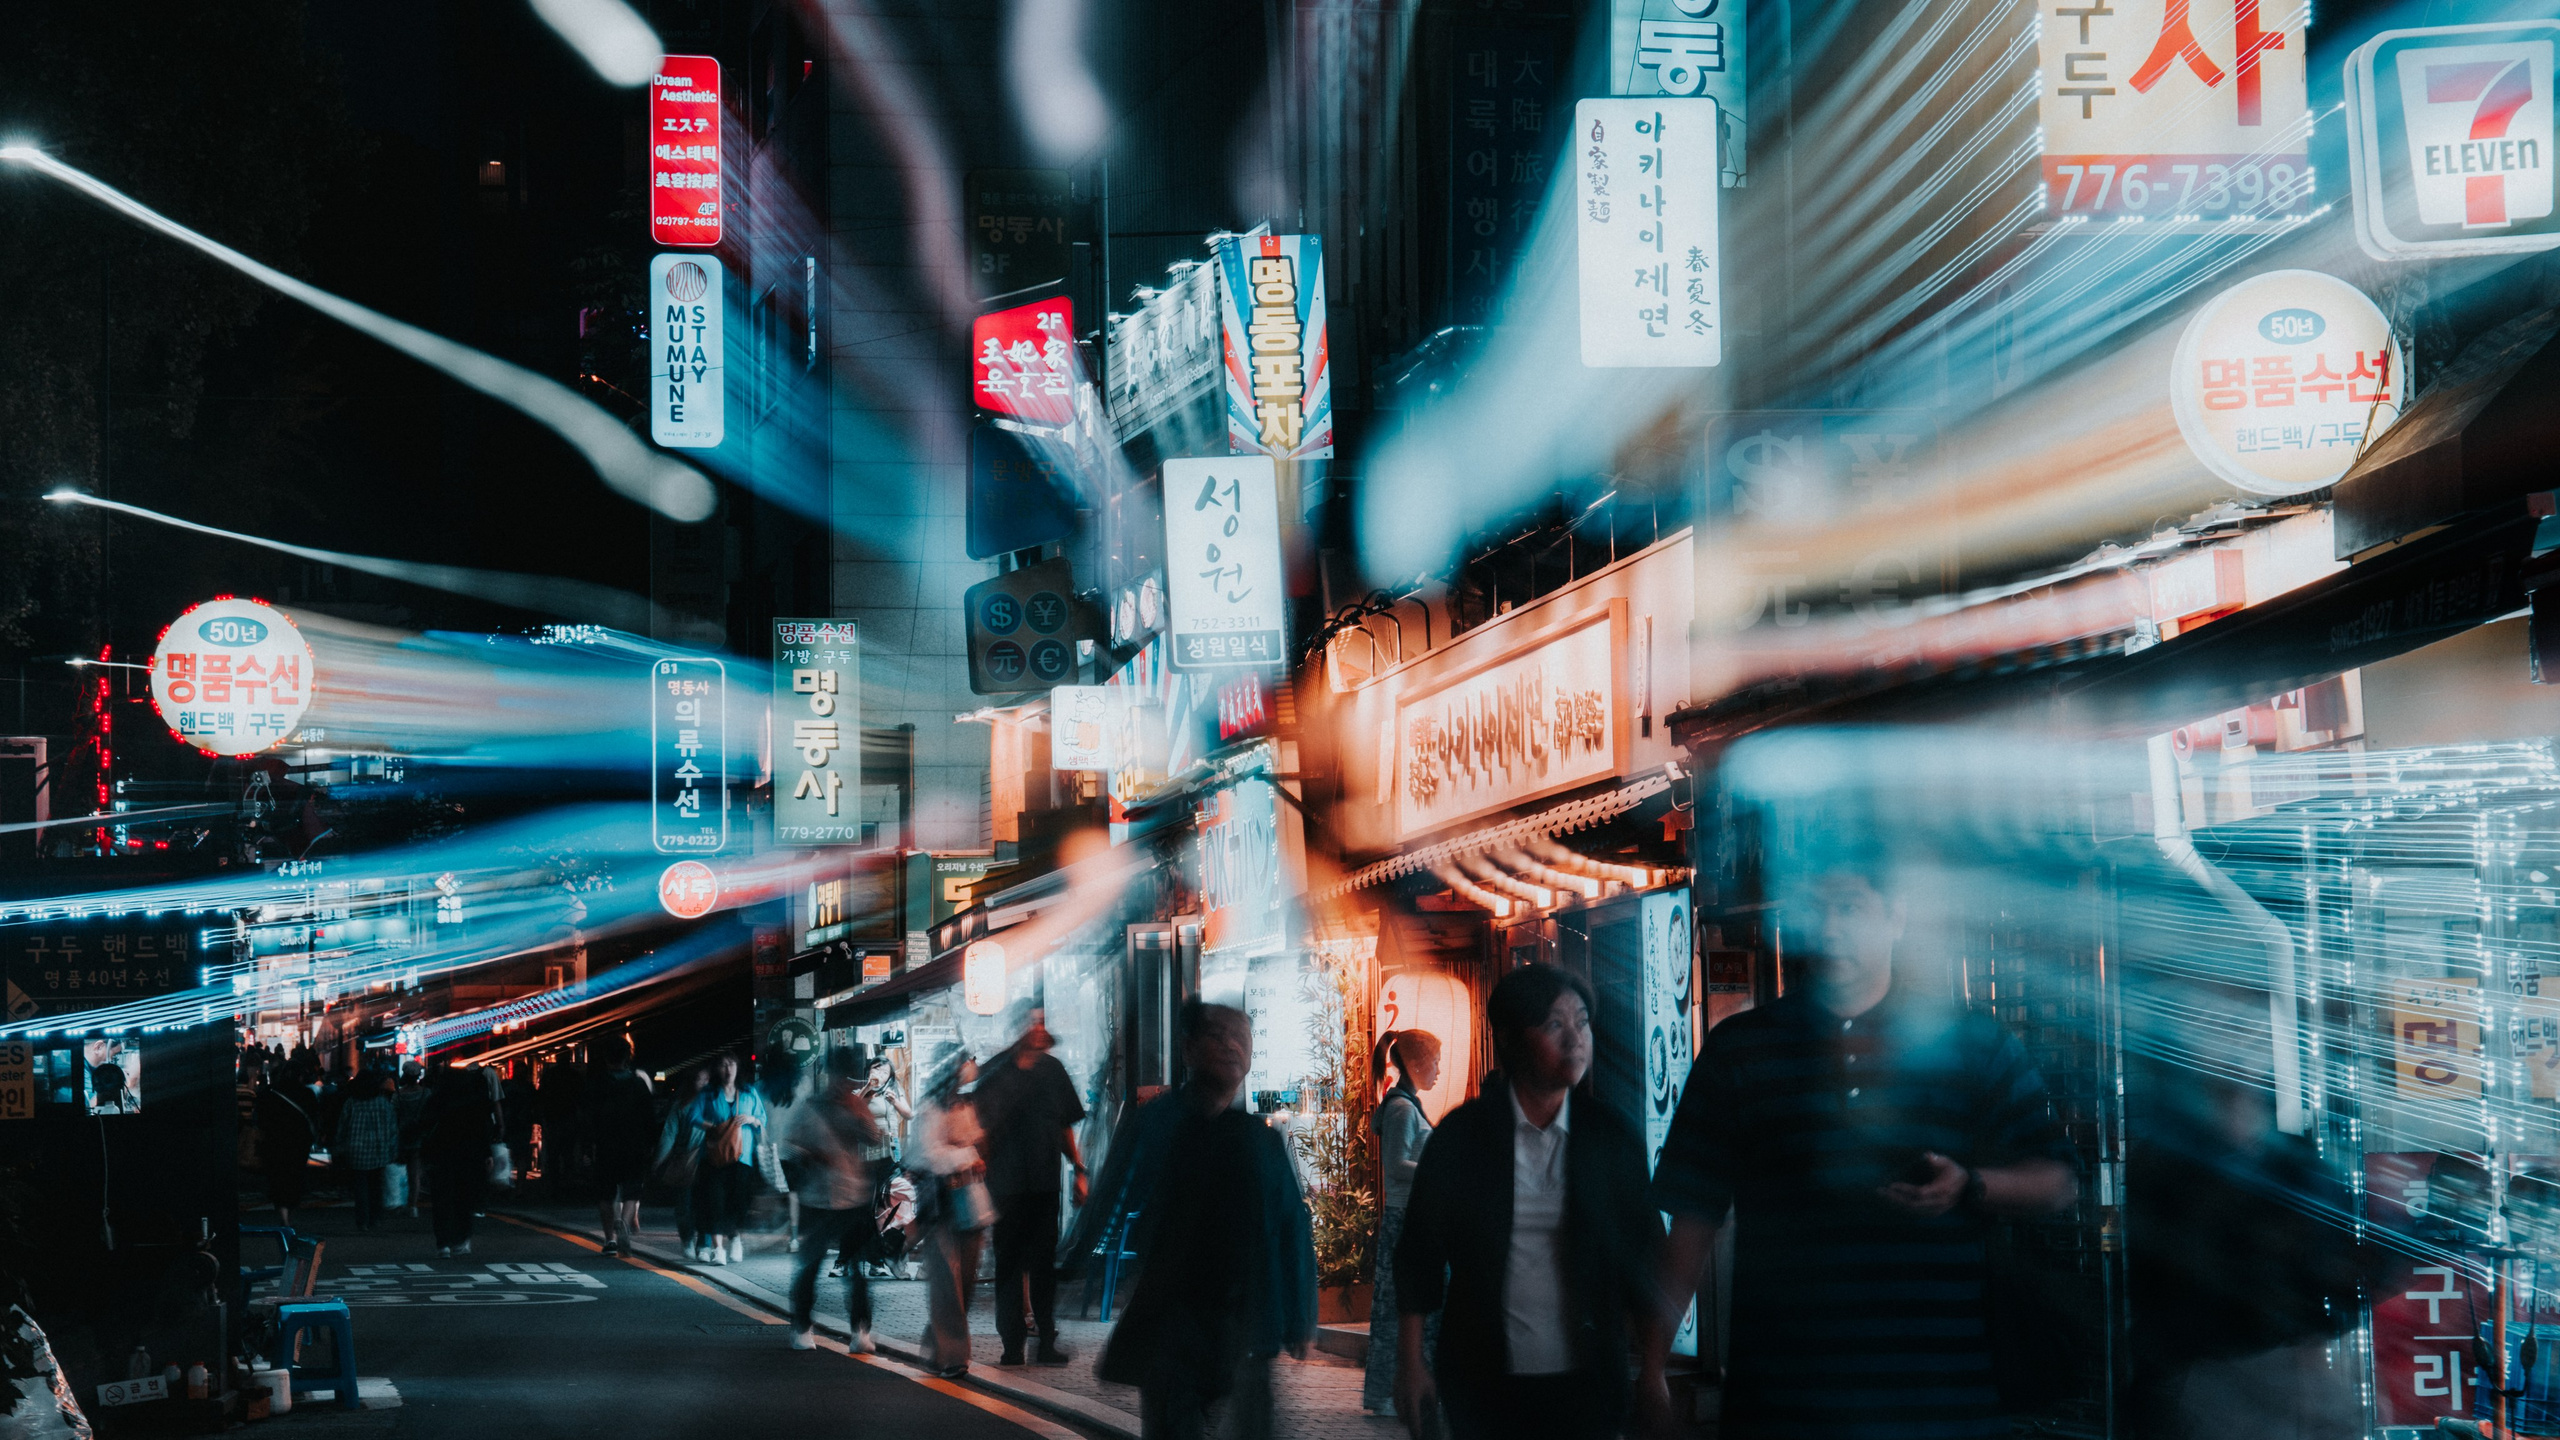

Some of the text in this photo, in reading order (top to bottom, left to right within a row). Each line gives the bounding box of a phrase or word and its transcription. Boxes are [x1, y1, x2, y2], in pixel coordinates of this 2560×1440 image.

[654, 74, 692, 87] Dream
[660, 88, 717, 103] Aesthetic
[663, 118, 709, 133] エステ
[655, 144, 717, 162] 에스테틱
[1465, 50, 1501, 286] 대륙여행사
[655, 172, 718, 189] 美容按摩
[2057, 163, 2297, 211] 776-7398
[698, 202, 717, 215] 4F
[656, 216, 718, 226] 02)797-9633
[979, 215, 1065, 245] 명동사
[1634, 110, 1670, 338] 아키나이제면
[981, 253, 1010, 274] 3F
[1684, 245, 1713, 336] 春夏冬
[1036, 312, 1062, 329] 2F
[2270, 316, 2315, 338] 50년
[690, 305, 708, 384] STAY
[978, 335, 1069, 370] 王妃家
[1249, 256, 1305, 448] 명동포차
[666, 305, 687, 423] MUMUNE
[2201, 350, 2391, 411] 명품수선
[1194, 474, 1254, 605] 성원
[209, 621, 258, 643] 50년
[778, 622, 857, 645] 명품수선
[1191, 615, 1262, 631] 752-3311
[1186, 634, 1270, 658] 성원일식
[166, 652, 299, 706] 명품수선
[661, 663, 678, 675] B1
[667, 680, 710, 696] 명동사
[301, 728, 325, 743] 부동산
[792, 668, 843, 817] 명동사
[673, 698, 703, 819] 의류수선
[661, 835, 718, 846] 779-0222
[780, 826, 855, 840] 779-2770
[936, 862, 967, 872] 오리지날
[665, 878, 712, 901] 사주
[26, 933, 189, 964] 구두 핸드백
